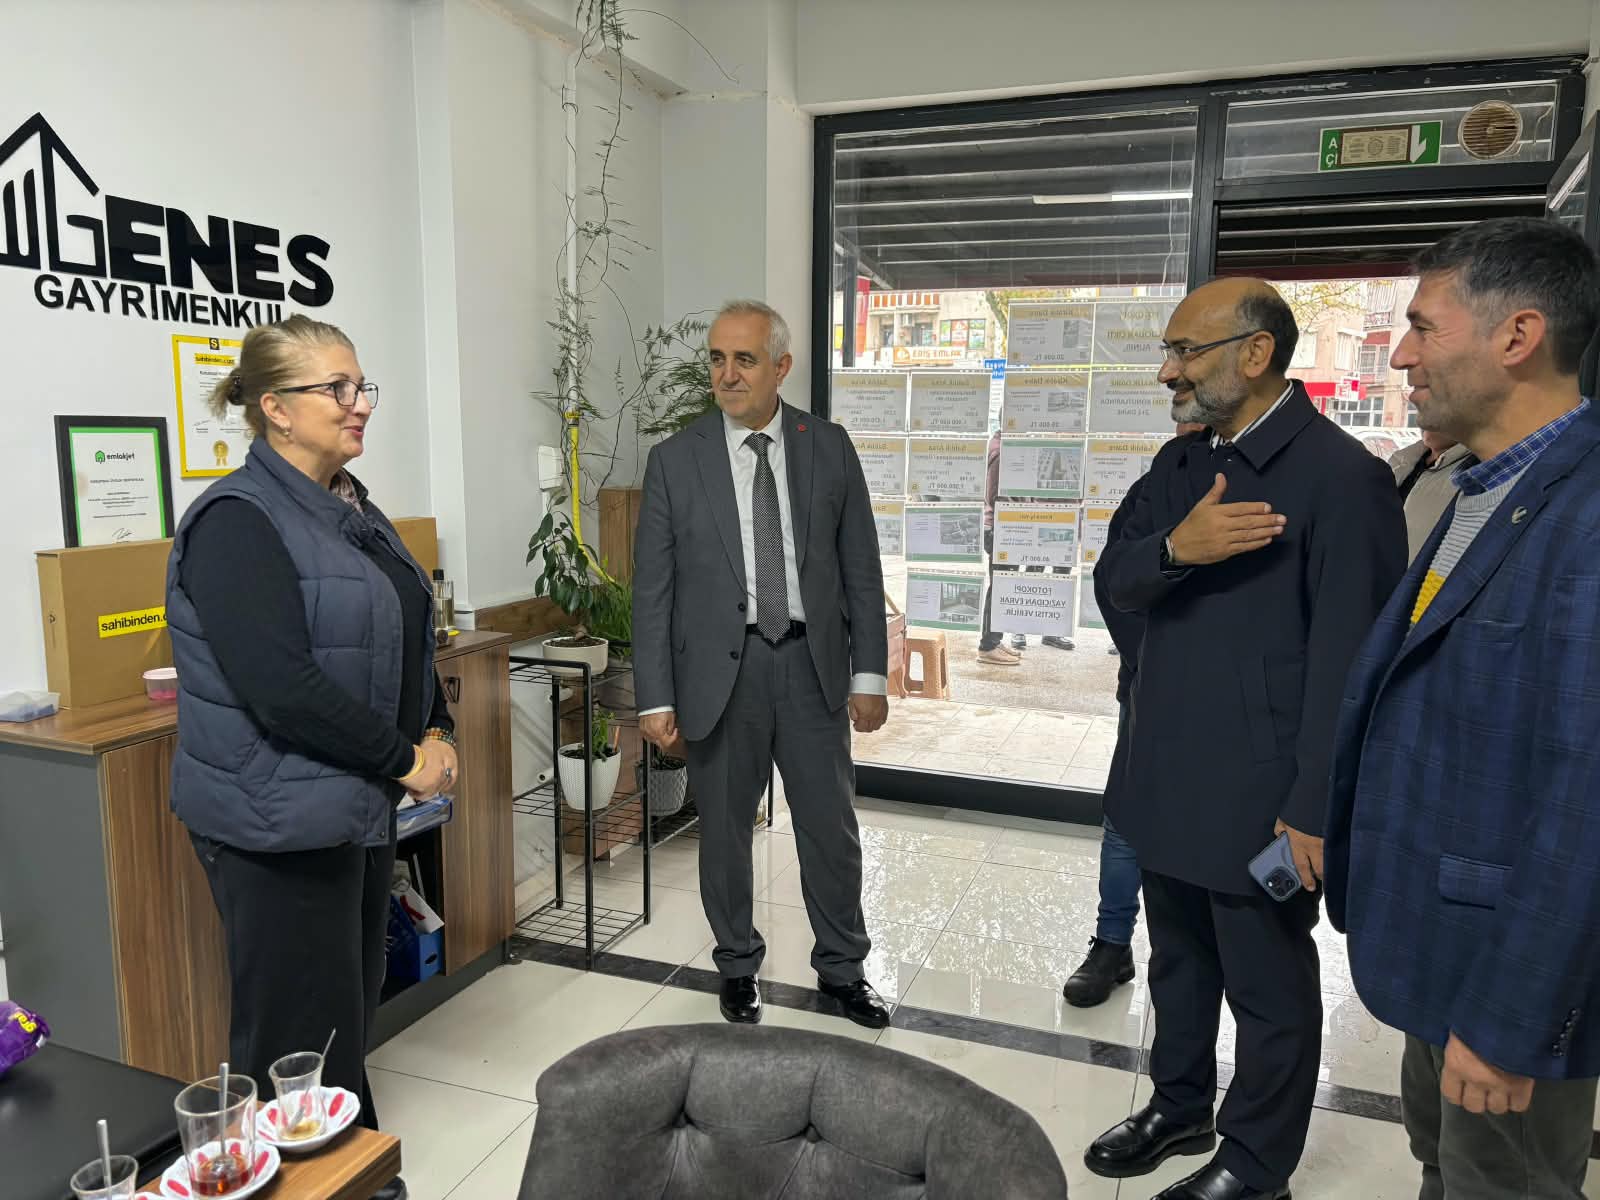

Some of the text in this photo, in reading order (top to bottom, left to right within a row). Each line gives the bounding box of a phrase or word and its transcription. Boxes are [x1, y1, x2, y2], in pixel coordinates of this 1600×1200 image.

[44, 195, 334, 307] GENES
[106, 452, 135, 461] emlakjet
[101, 612, 167, 632] sahibinden.c
